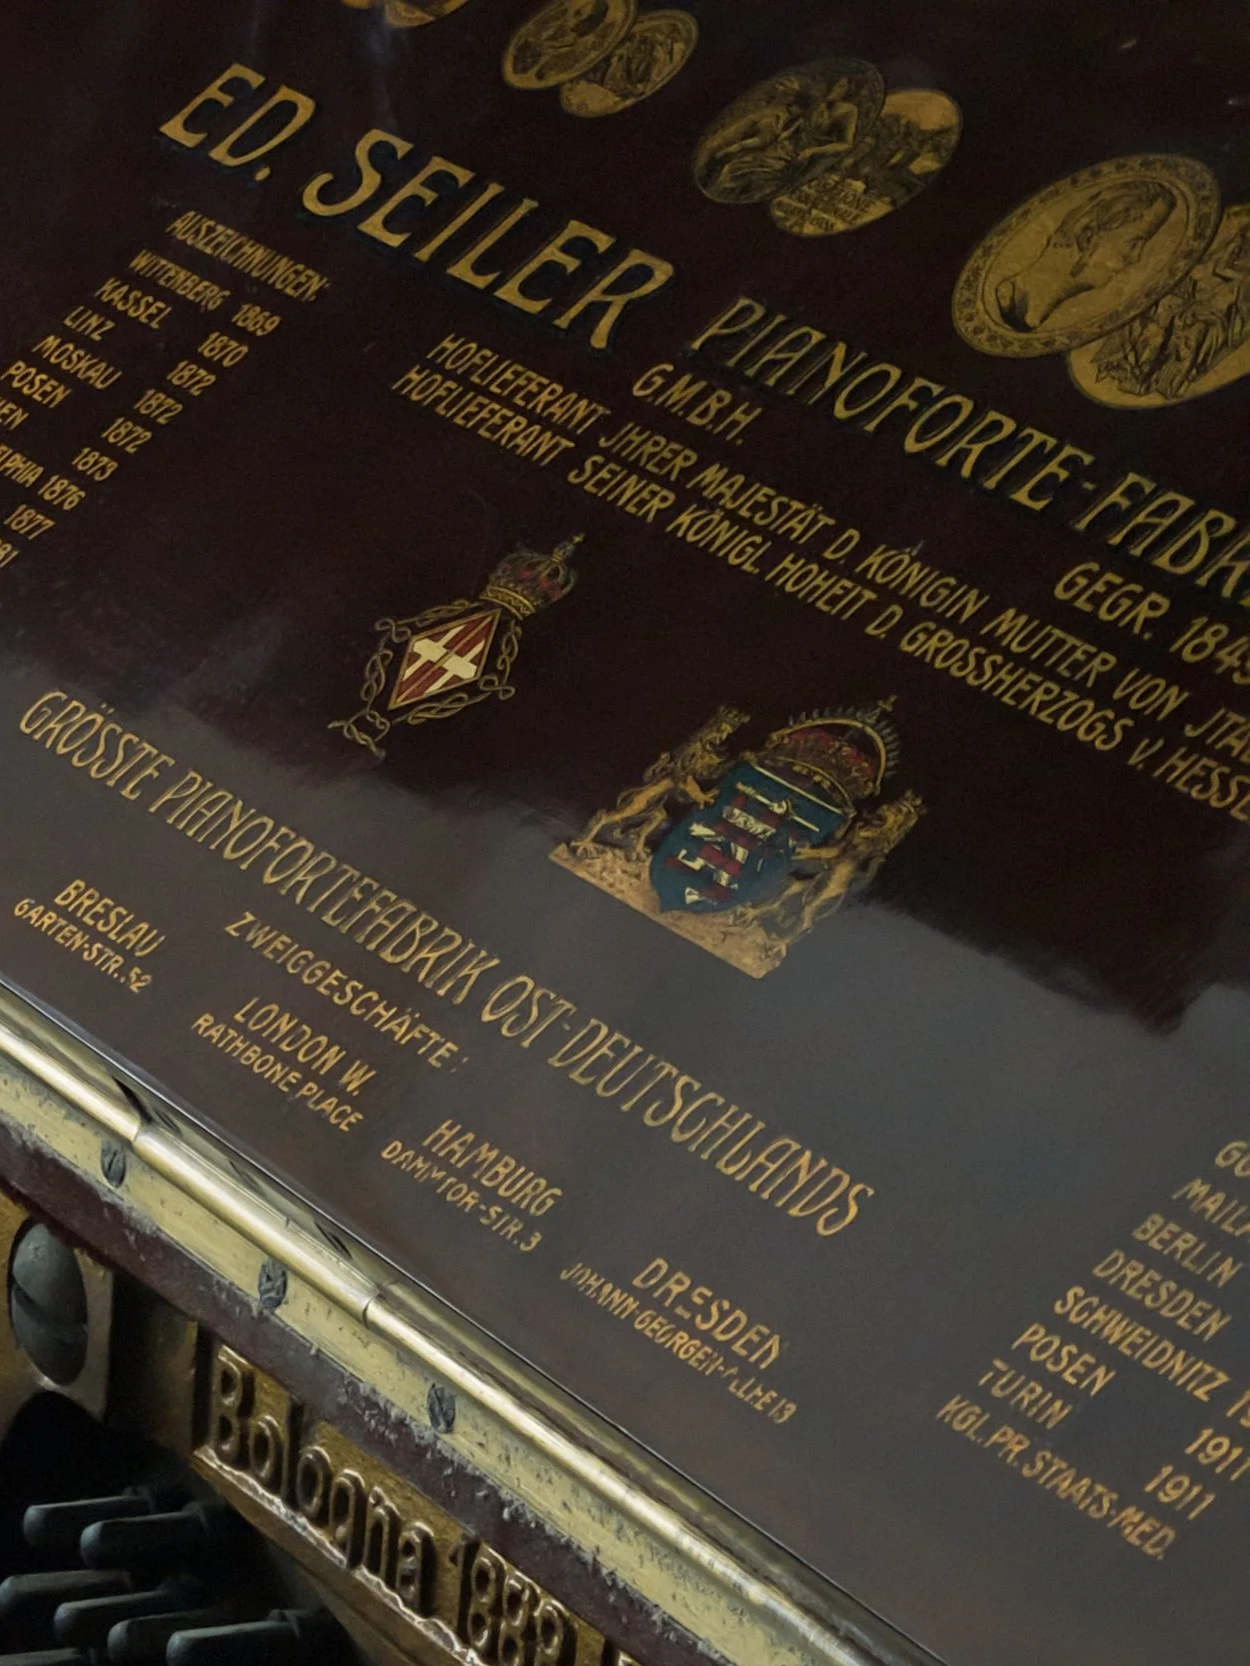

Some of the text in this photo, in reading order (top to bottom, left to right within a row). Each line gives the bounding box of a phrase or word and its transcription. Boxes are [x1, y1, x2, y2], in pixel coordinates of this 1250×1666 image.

[62, 305, 217, 397] LINZ 1872
[94, 277, 249, 368] KASSEL 1870
[158, 62, 1250, 607] ED. SEILER PIANOFORTE-FABR
[231, 303, 282, 337] 1869
[0, 360, 152, 454] POSEN 1872
[31, 334, 184, 425] MOSKAU 1872
[38, 475, 86, 510] 1876
[71, 447, 119, 481] 1873
[4, 504, 55, 540] 1877
[391, 364, 576, 466] HOFLIEFERANT
[567, 454, 676, 523] SEINER
[665, 503, 773, 575] KÖNIGL.
[764, 553, 878, 621] HOHEIT
[864, 604, 904, 639] D.
[901, 621, 1135, 751] GROSSHERZOGS
[1127, 737, 1165, 771] V.
[426, 331, 612, 435] HOFLIEFERANT
[686, 462, 836, 545] MAJESTÄT
[822, 528, 861, 565] D.
[854, 544, 990, 624] KÖNIGIN
[980, 607, 1117, 688] MUTTER
[1112, 667, 1191, 721] VON
[1053, 561, 1171, 640] GEGR.
[17, 690, 875, 1238] GRÖSSTE PIANOFORTEFABRIK OST-DEUTSCHLANDS
[54, 878, 166, 958] BRESLAU
[190, 1012, 365, 1133] RATHBONE PLACE
[233, 996, 378, 1097] LONDON W.
[422, 1119, 563, 1217] HAMBURG
[1092, 1248, 1233, 1343] DRESDEN
[1132, 1212, 1243, 1289] BERLIN
[631, 1256, 788, 1370] DRESDEN
[1054, 1285, 1232, 1403] SCHWEIDNITZ
[977, 1358, 1217, 1522] TURIN 1911
[1011, 1322, 1250, 1484] POSEN 1911
[210, 1344, 438, 1614] Bologna
